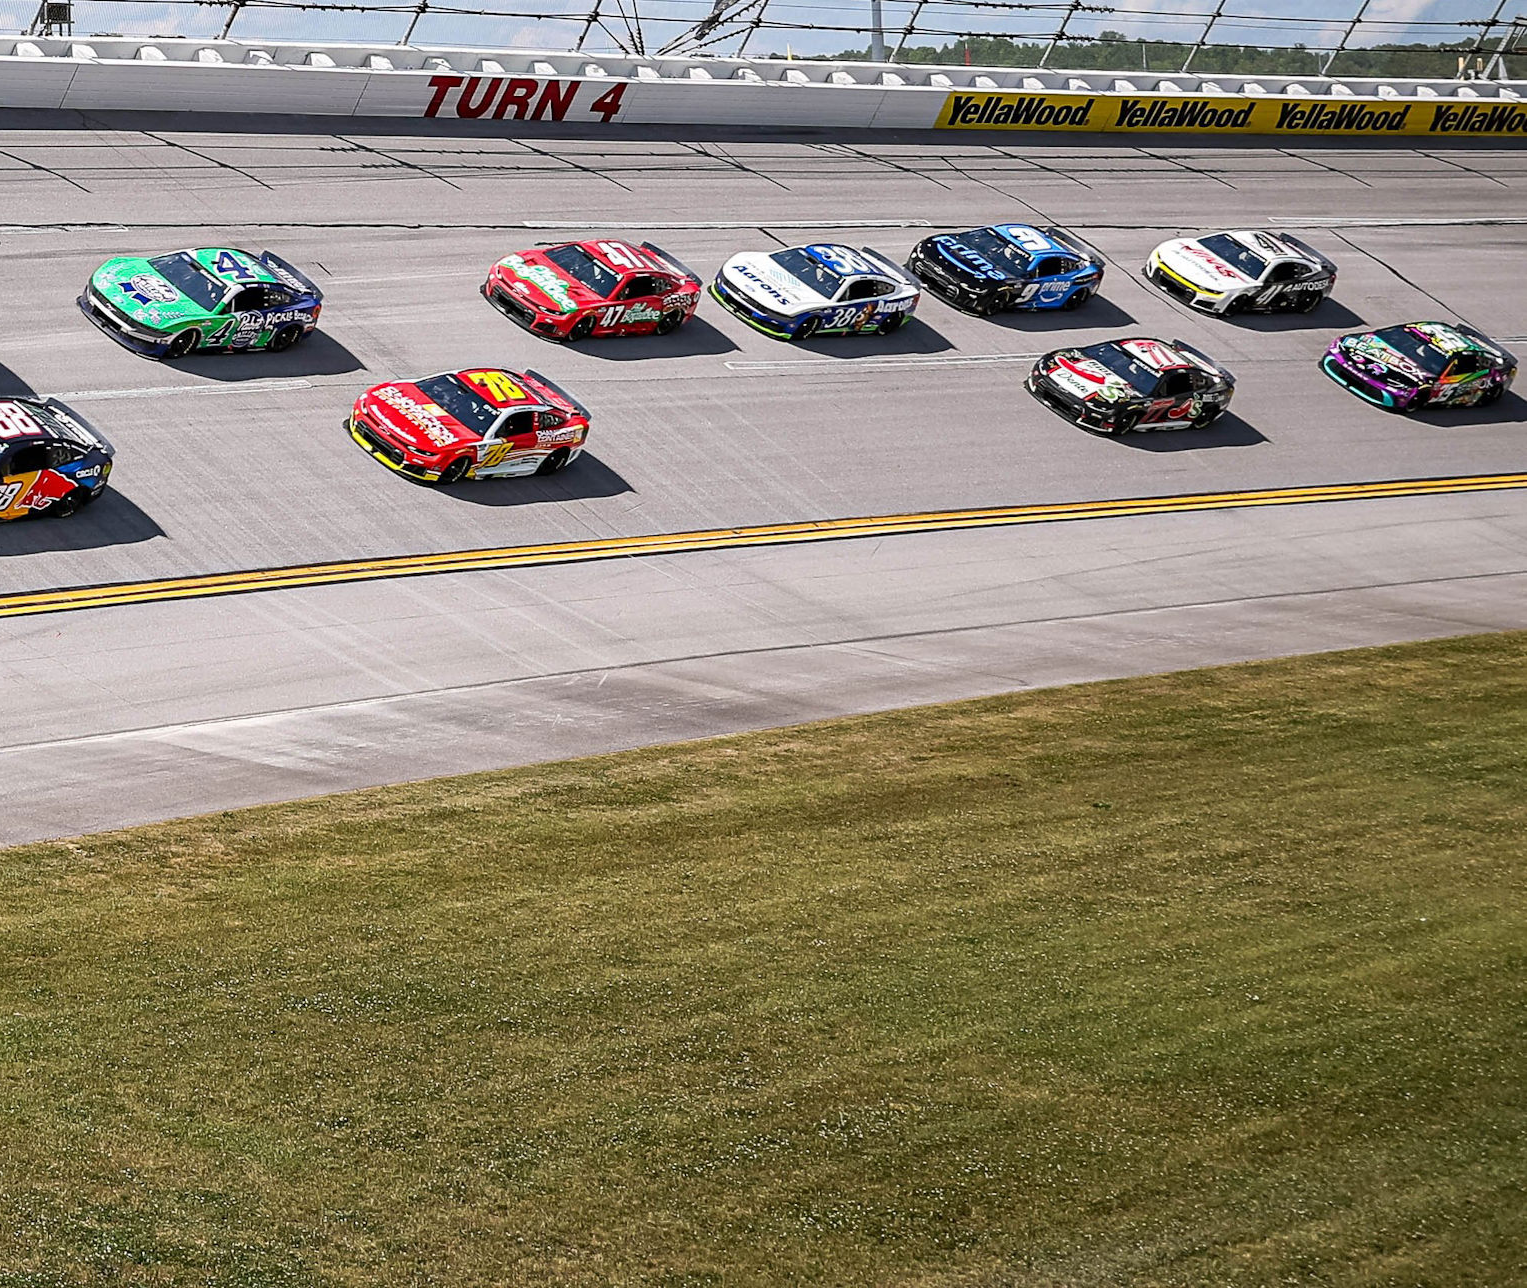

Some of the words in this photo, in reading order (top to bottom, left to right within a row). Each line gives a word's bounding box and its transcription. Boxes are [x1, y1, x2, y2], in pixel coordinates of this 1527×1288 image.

[424, 76, 581, 122] TURN
[590, 82, 628, 122] 4
[948, 96, 1095, 125] YellaWood
[1115, 99, 1256, 127] YellaWood
[1276, 103, 1412, 131] YellaWood
[1429, 105, 1527, 132] YellaWo
[215, 252, 258, 280] 4
[597, 242, 644, 269] 47
[1015, 284, 1040, 303] 9
[1038, 279, 1070, 294] prime
[1292, 279, 1329, 292] AUTODESK
[600, 305, 625, 328] 47
[825, 307, 854, 328] 38
[207, 319, 235, 346] 4
[1345, 338, 1428, 380] BEATBOX
